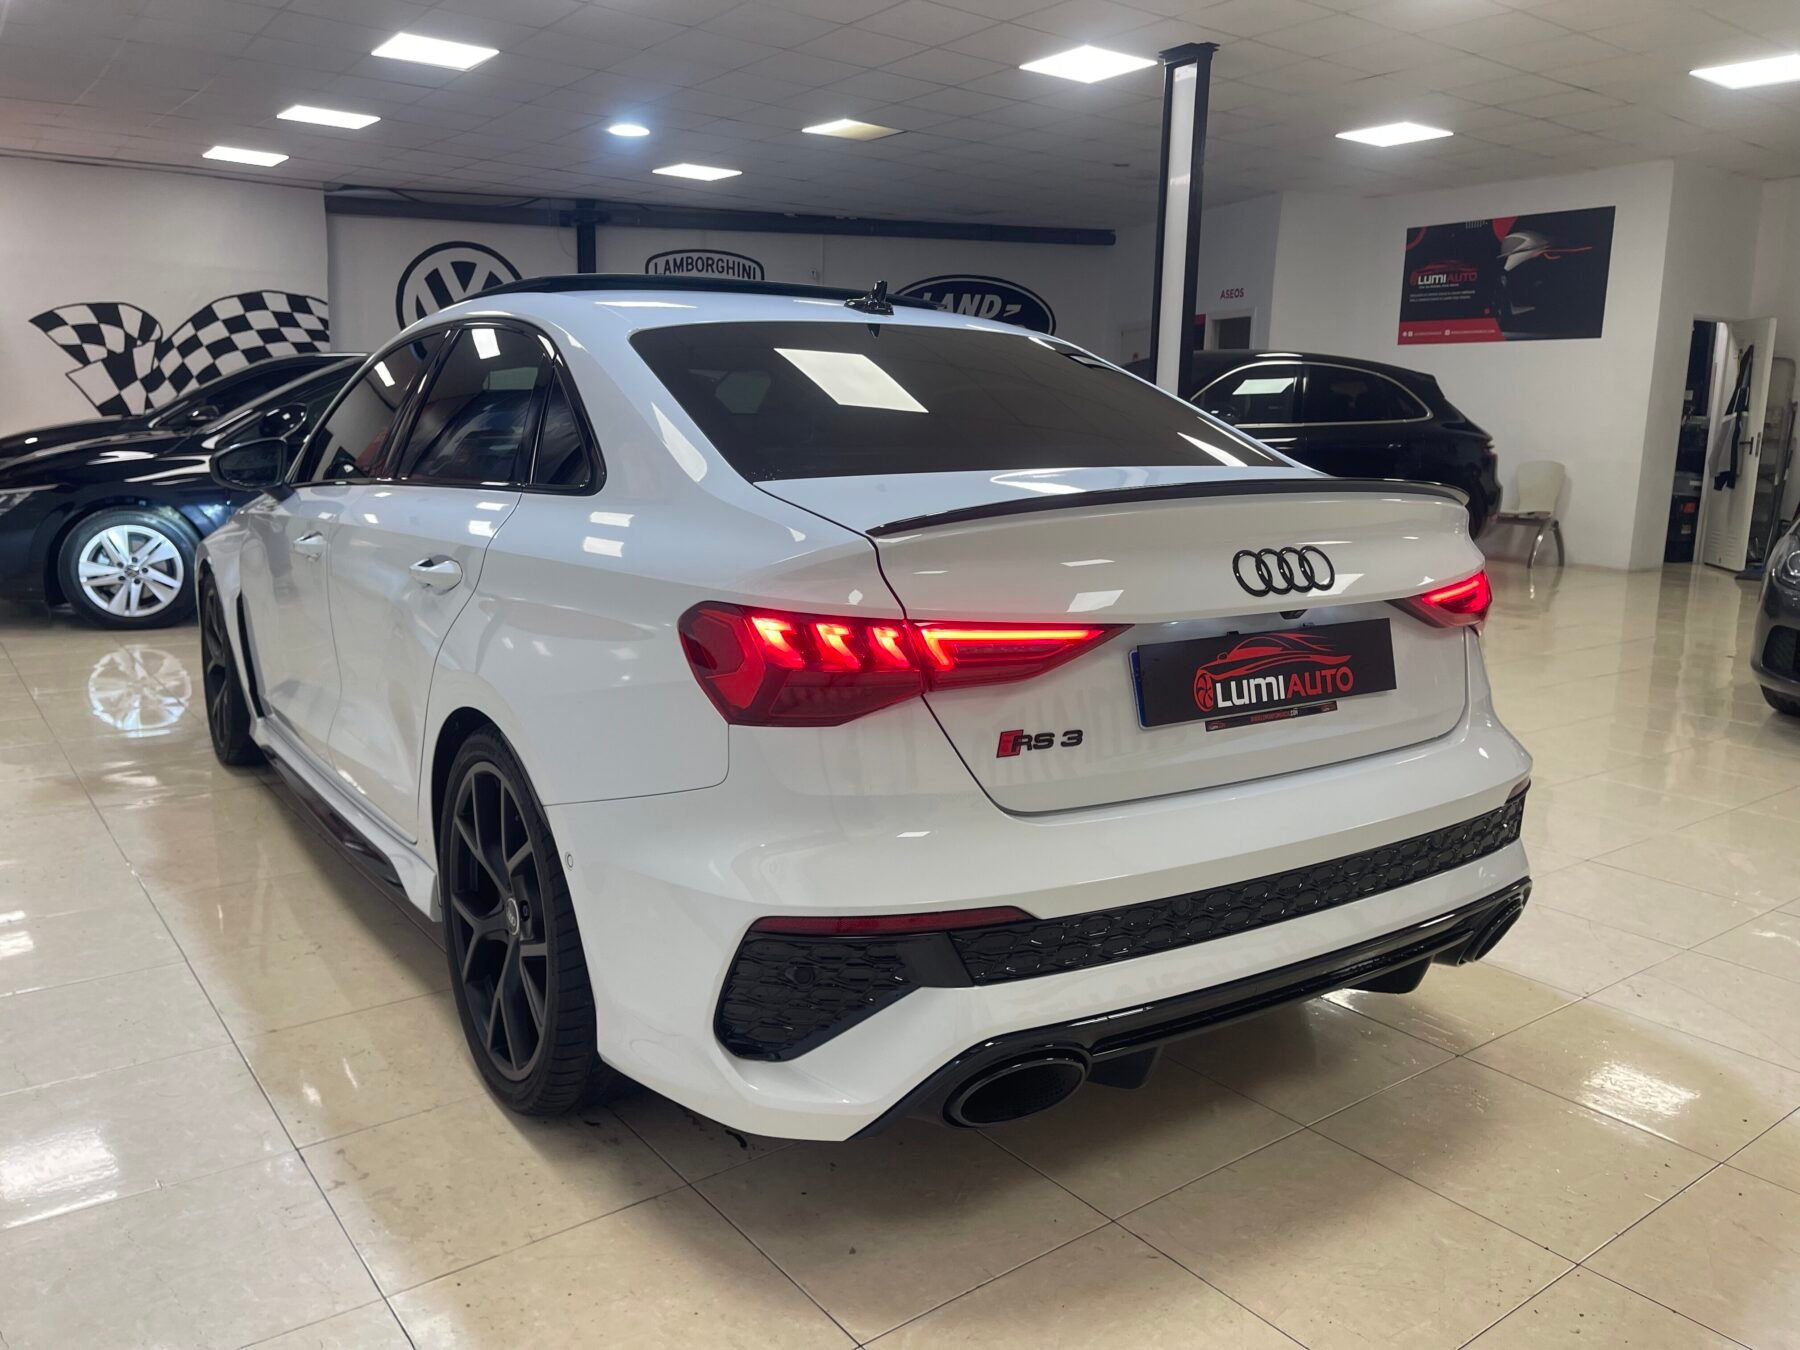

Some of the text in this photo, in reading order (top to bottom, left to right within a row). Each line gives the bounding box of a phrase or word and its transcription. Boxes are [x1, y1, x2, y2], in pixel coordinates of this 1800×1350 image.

[1220, 287, 1245, 299] ASEOS
[1010, 729, 1084, 753] RS 3
